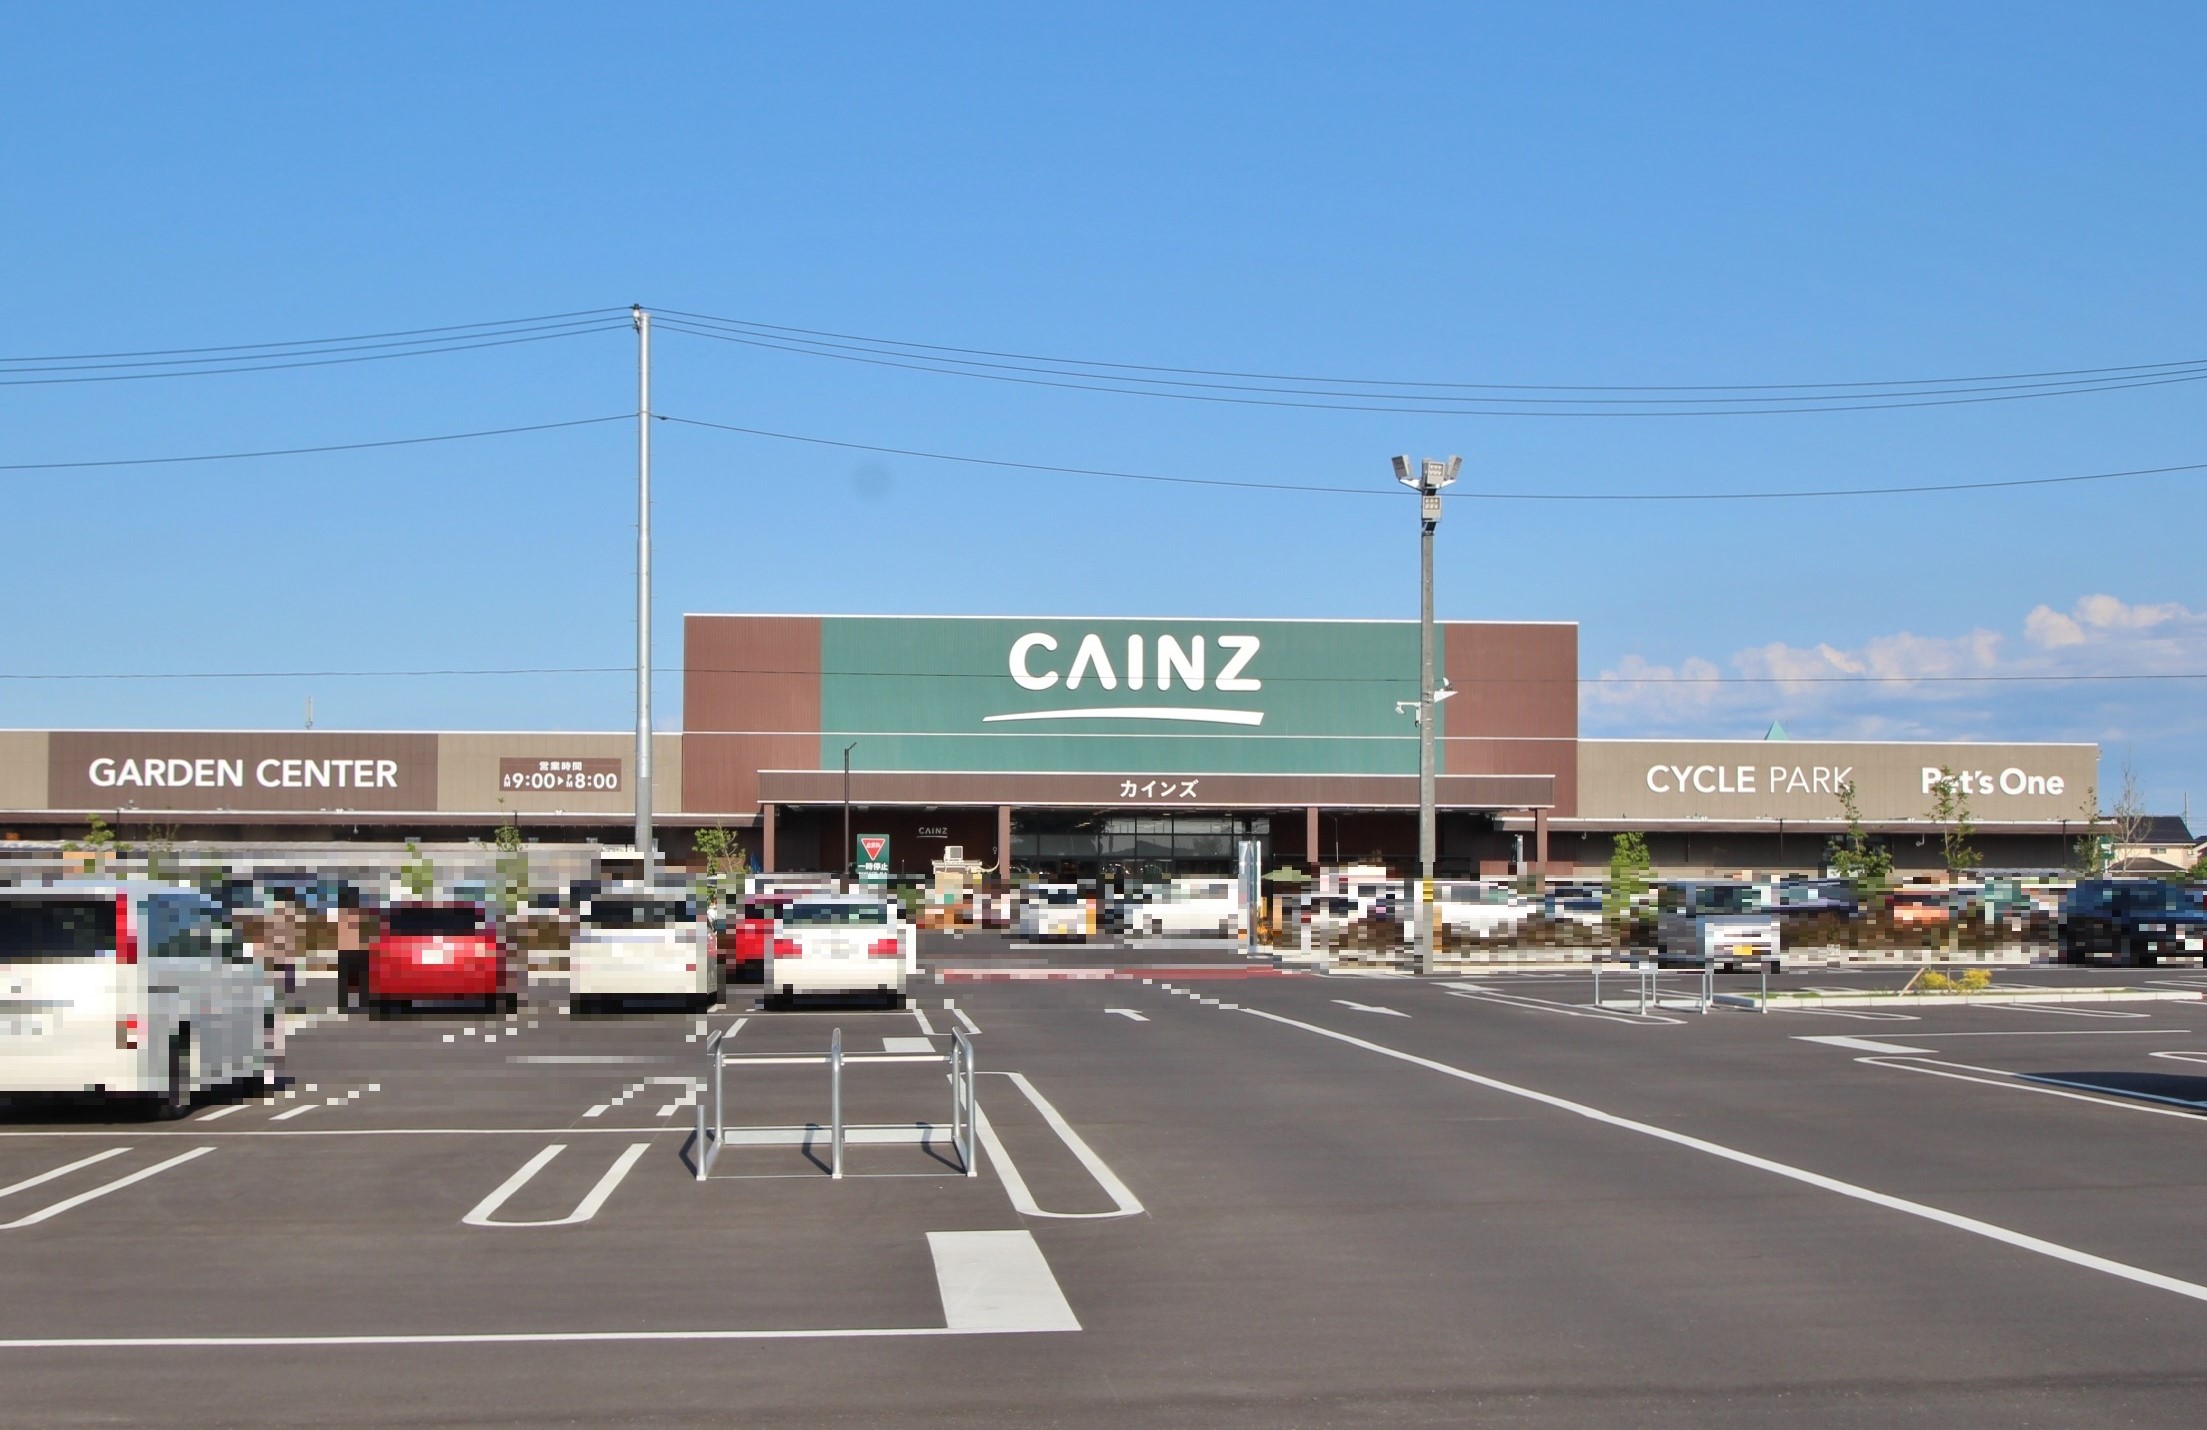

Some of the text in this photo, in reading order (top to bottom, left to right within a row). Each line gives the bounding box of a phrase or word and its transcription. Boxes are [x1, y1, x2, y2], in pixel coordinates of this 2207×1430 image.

[1008, 632, 1262, 691] CAINZ
[89, 758, 398, 788] GARDEN CENTER
[539, 761, 582, 771] 営業時間
[512, 772, 555, 789] 9:00
[575, 772, 617, 789] 8:00
[1120, 778, 1199, 798] カインズ
[1646, 765, 1853, 793] CYCLE PARK
[1999, 767, 2065, 796] One
[858, 862, 888, 871] 一時停止
